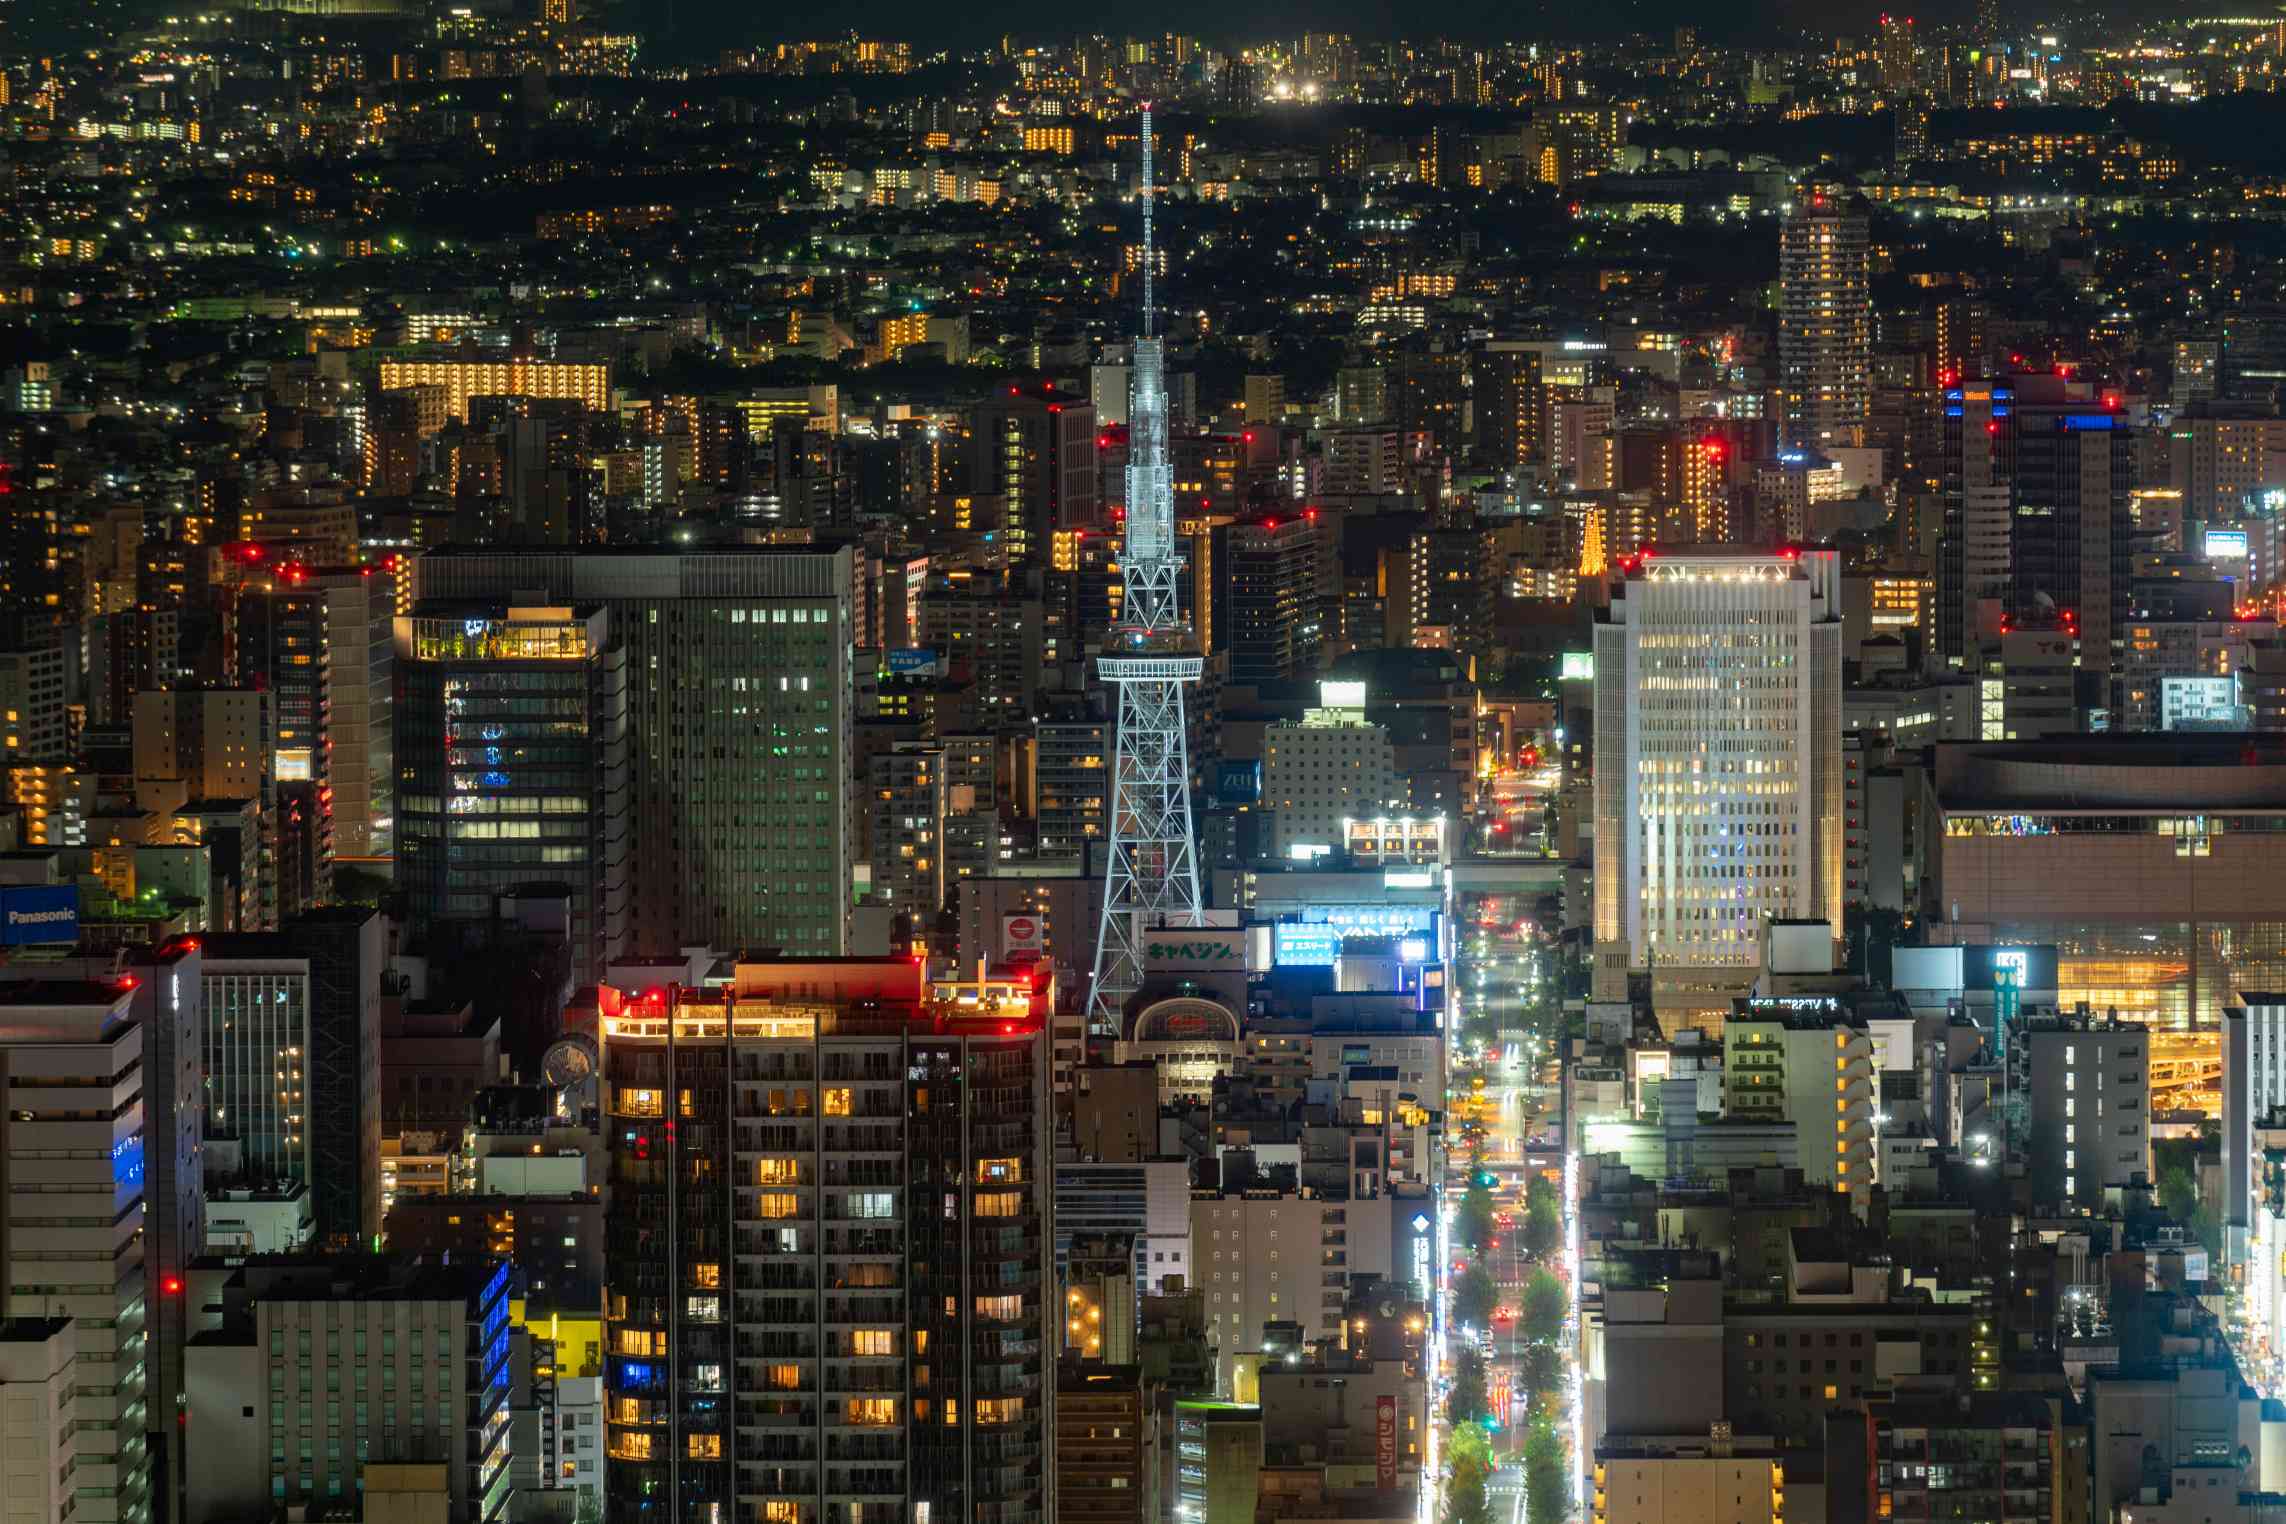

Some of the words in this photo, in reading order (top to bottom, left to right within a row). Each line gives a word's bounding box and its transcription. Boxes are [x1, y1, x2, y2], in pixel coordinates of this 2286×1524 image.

[8, 907, 76, 924] Panasonic
[1148, 943, 1232, 960] キャベジン
